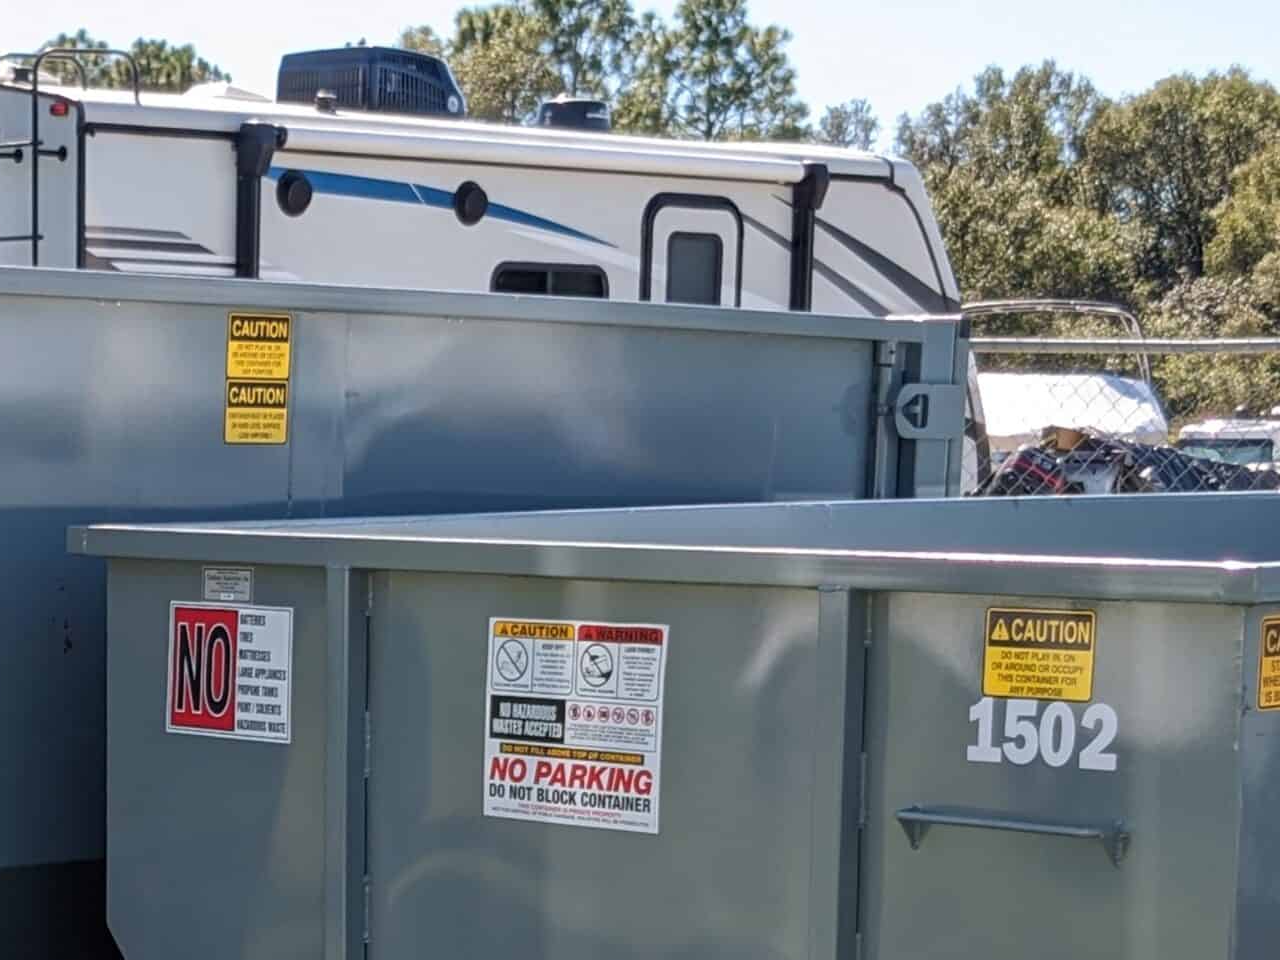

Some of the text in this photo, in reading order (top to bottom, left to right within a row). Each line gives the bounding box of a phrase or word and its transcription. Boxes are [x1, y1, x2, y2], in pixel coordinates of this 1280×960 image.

[232, 319, 288, 338] CAUTION
[229, 387, 285, 404] CAUTION
[510, 624, 569, 638] CAUTION
[598, 628, 659, 641] WARNING
[1011, 618, 1090, 643] CAUTION
[1001, 651, 1012, 660] DO
[1014, 651, 1029, 660] NOT
[1031, 652, 1049, 661] PLAY
[175, 622, 232, 717] NO
[991, 662, 1083, 674] OR AROUND OR OCCUPY
[998, 673, 1076, 686] THIS CONTAINER FOR
[1009, 686, 1062, 696] ANY PURPOSE
[967, 697, 1117, 771] 1502
[530, 746, 544, 754] FILL
[572, 749, 587, 758] TOP
[489, 756, 653, 795] NO PARKING
[489, 783, 651, 813] DO NOT BLOCK CONTAINER
